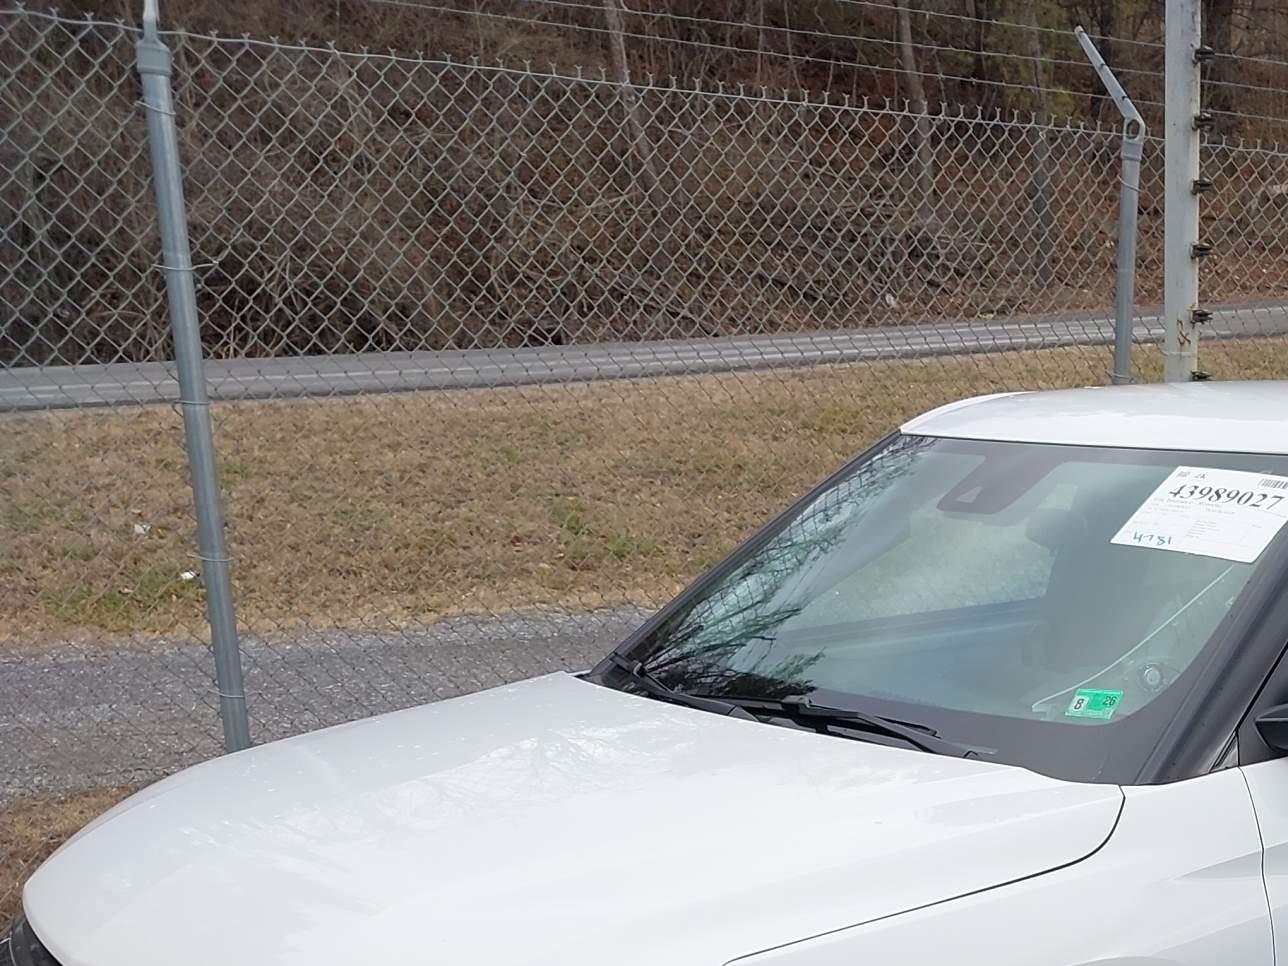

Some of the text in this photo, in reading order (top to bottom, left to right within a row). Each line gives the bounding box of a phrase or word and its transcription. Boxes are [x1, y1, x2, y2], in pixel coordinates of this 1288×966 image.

[1169, 484, 1286, 511] 43989027
[1073, 695, 1118, 711] 8 26
